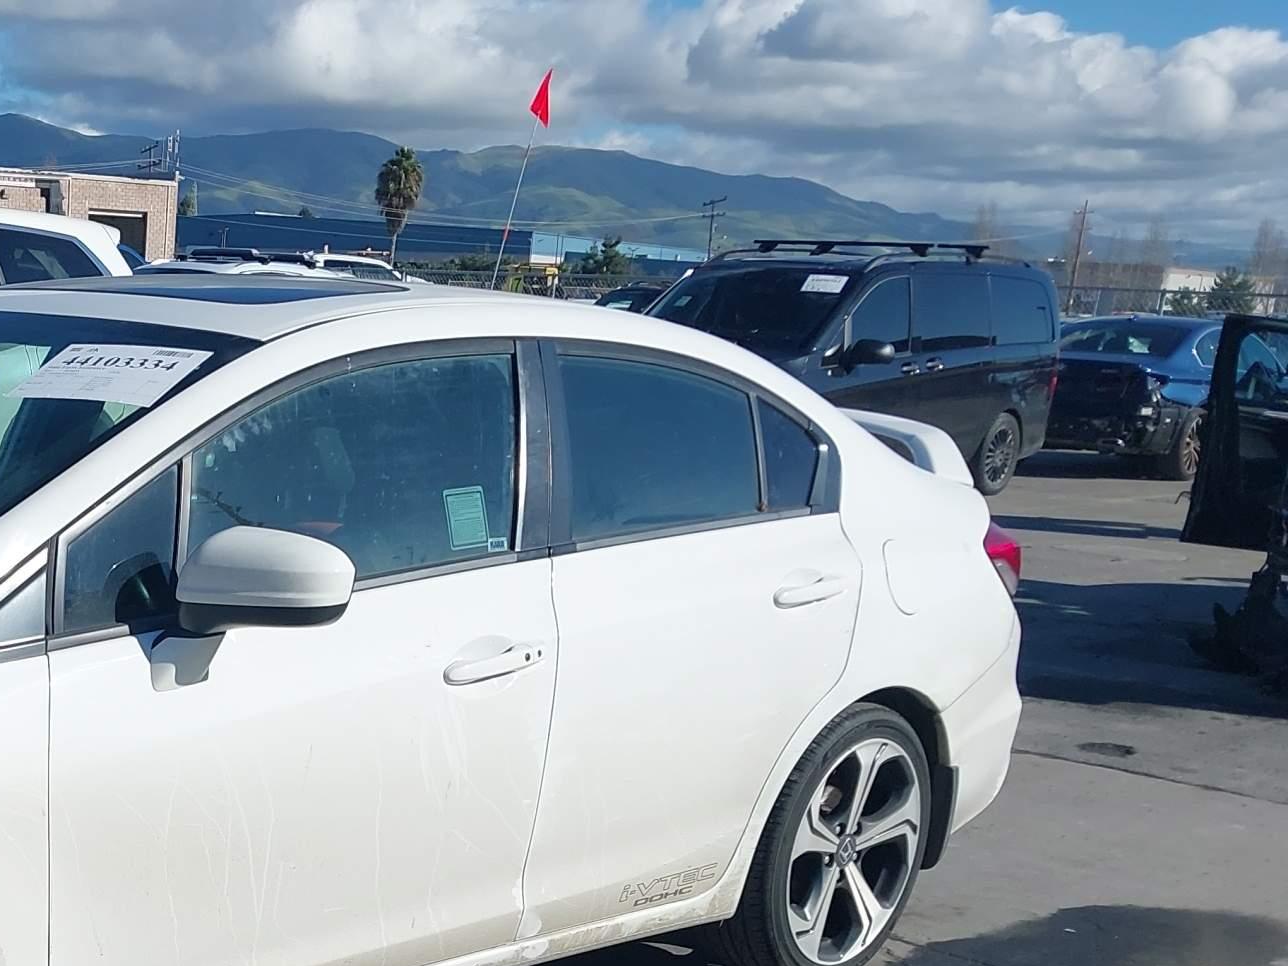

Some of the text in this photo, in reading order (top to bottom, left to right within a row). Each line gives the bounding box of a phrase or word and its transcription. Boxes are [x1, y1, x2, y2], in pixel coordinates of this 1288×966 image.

[62, 355, 180, 372] 44103334
[618, 862, 718, 903] i-VTEC
[633, 885, 693, 907] DOHC
